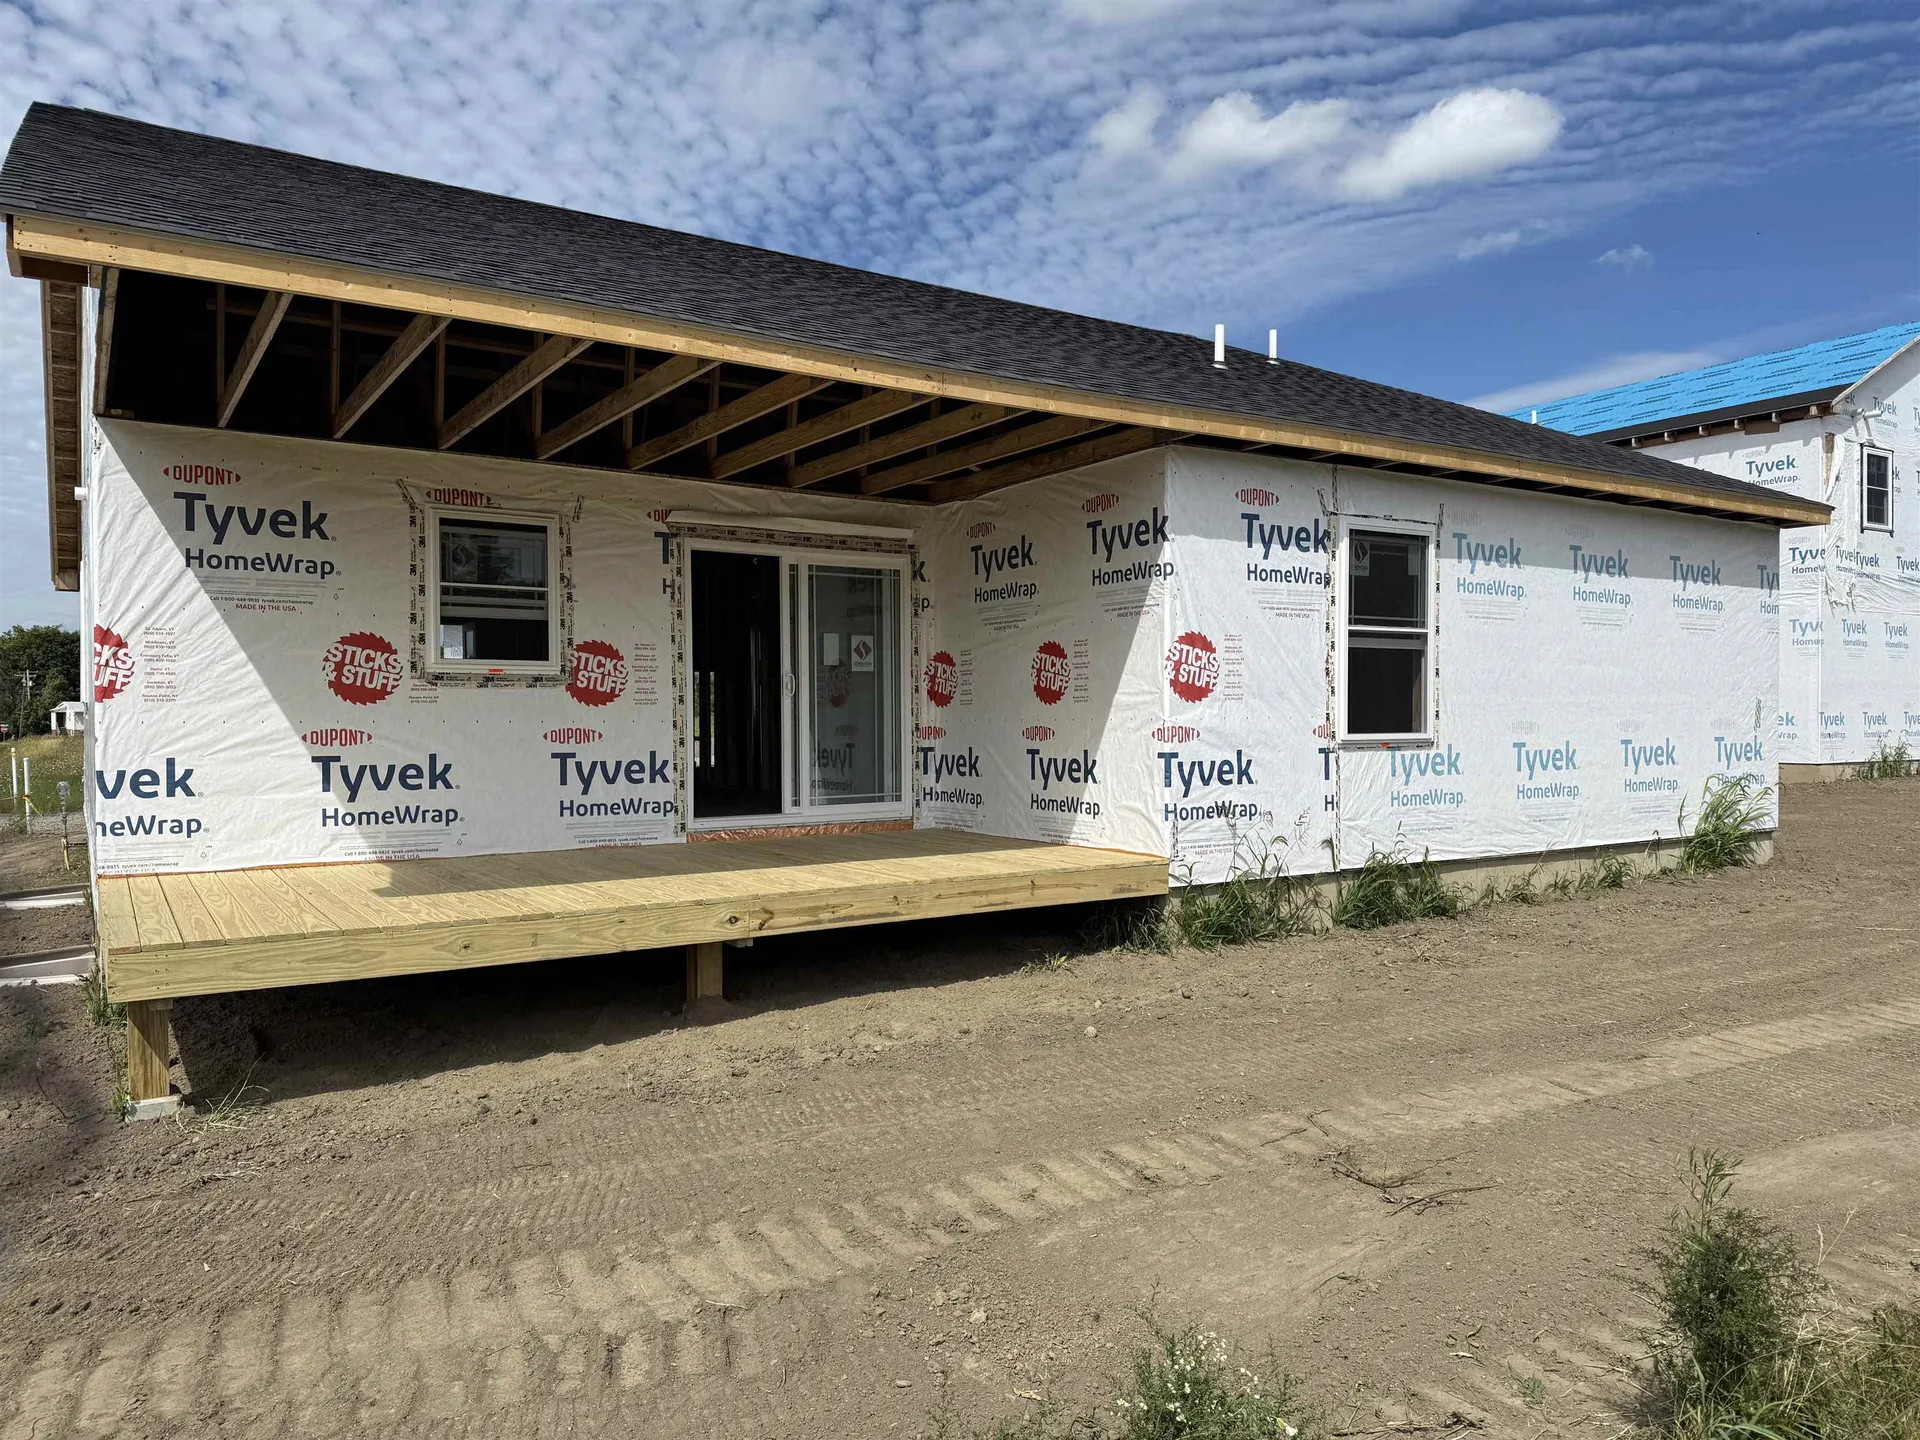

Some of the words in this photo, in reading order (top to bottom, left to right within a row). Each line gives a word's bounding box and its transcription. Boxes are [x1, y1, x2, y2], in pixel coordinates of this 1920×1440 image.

[173, 465, 233, 485] DUPONT
[1746, 455, 1796, 478] Tyvek
[434, 488, 485, 506] DUPONT
[1086, 493, 1116, 513] DUPONT
[1240, 489, 1275, 507] DUPONT
[173, 491, 330, 545] Tyvek
[410, 515, 417, 527] 3M
[970, 522, 993, 539] DUPONT
[1086, 507, 1170, 563] Tyvek
[1241, 513, 1329, 560] Tyvek
[419, 536, 426, 548] 3M
[566, 546, 572, 558] 3M
[185, 548, 335, 579] HomeWrap
[971, 534, 1034, 583] Tyvek
[1452, 532, 1522, 575] Tyvek
[1569, 544, 1628, 583] Tyvek
[1789, 547, 1826, 564] Tyve
[1856, 551, 1880, 570] Tyvek
[410, 564, 417, 576] 3M
[1092, 560, 1174, 586] HomeWrap
[1669, 555, 1721, 591] Tyvek
[1896, 556, 1920, 574] Tyvek
[1247, 563, 1332, 589] HomeWrap
[1757, 564, 1779, 598] Tyv
[419, 585, 426, 597] 3M
[567, 592, 573, 603] 3M
[974, 582, 1037, 603] HomeWrap
[1457, 577, 1524, 601] HomeWrap
[1573, 586, 1631, 608] HomeWrap
[1672, 594, 1723, 613] HomeWrap
[410, 612, 417, 625] 3M
[1842, 619, 1867, 637] Tyvek
[419, 633, 426, 645] 3M
[1884, 622, 1908, 640] Tyvek
[567, 638, 574, 649] 3M
[1843, 639, 1868, 649] HomeWrap
[1886, 640, 1909, 650] HomeWrap
[94, 642, 134, 670] CKS
[327, 642, 402, 674] STICKS
[567, 651, 629, 679] STICKS
[1033, 652, 1070, 677] STICKS
[1169, 641, 1220, 672] STICKS
[94, 666, 132, 690] UFF
[322, 661, 337, 682] &
[341, 665, 400, 692] STUFF
[410, 661, 417, 674] 3M
[1165, 660, 1176, 680] &
[1179, 664, 1219, 690] STUFF
[576, 670, 628, 695] STUFF
[1040, 671, 1070, 693] STUFF
[1818, 712, 1845, 730] Tyvek
[1863, 711, 1888, 729] Tyvek
[1904, 711, 1920, 729] Tyve
[311, 728, 365, 747] DUPONT
[550, 728, 596, 744] DUPONT
[916, 726, 944, 740] DUPONT
[1025, 726, 1052, 741] DUPONT
[1157, 726, 1196, 744] DUPONT
[1513, 740, 1577, 780] Tyvek
[1621, 738, 1676, 775] Tyvek
[1714, 735, 1763, 770] Tyvek
[551, 751, 670, 796] Tyvek
[918, 746, 980, 784] Tyvek
[1026, 749, 1098, 790] Tyvek
[1157, 749, 1254, 798] Tyvek
[1386, 744, 1461, 786] Tyvek
[96, 757, 196, 800] vek
[311, 753, 454, 803] Tyvek
[1625, 777, 1678, 794] HomeWrap
[923, 786, 982, 808] HomeWrap
[1390, 789, 1464, 808] HomeWrap
[1517, 782, 1579, 800] HomeWrap
[322, 805, 459, 827] HomeWrap
[559, 798, 674, 817] HomeWrap
[1031, 793, 1100, 819] HomeWrap
[1164, 800, 1258, 821] HomeWrap
